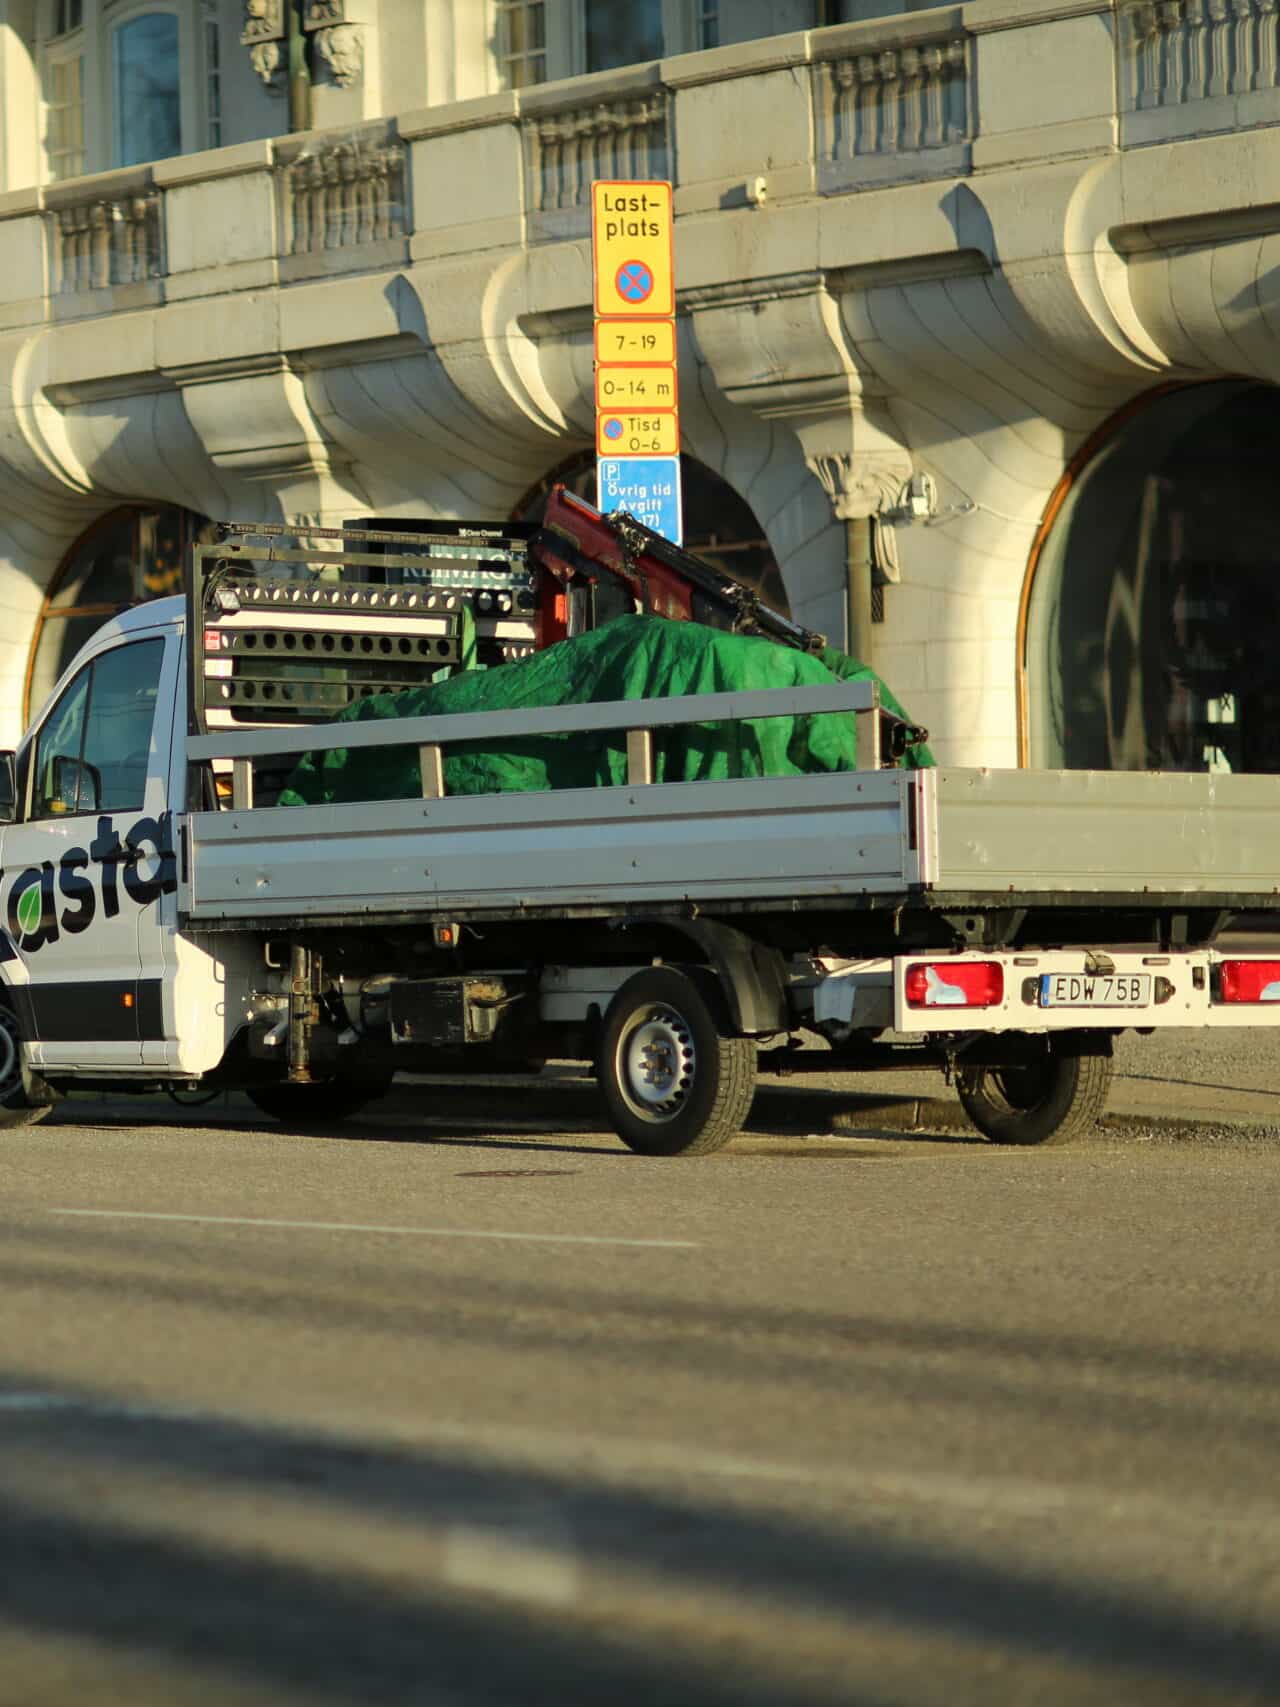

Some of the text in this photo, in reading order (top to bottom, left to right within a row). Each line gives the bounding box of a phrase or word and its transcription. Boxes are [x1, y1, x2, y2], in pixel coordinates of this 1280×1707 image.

[604, 193, 661, 212] Last-
[606, 218, 660, 240] plats
[603, 381, 670, 395] 0-14 m
[628, 418, 661, 431] Tisd
[630, 438, 661, 451] 0-6
[607, 465, 618, 478] P
[607, 481, 672, 498] Övrig tid
[619, 499, 662, 514] Avgift
[1055, 978, 1140, 1001] EDW 75B
